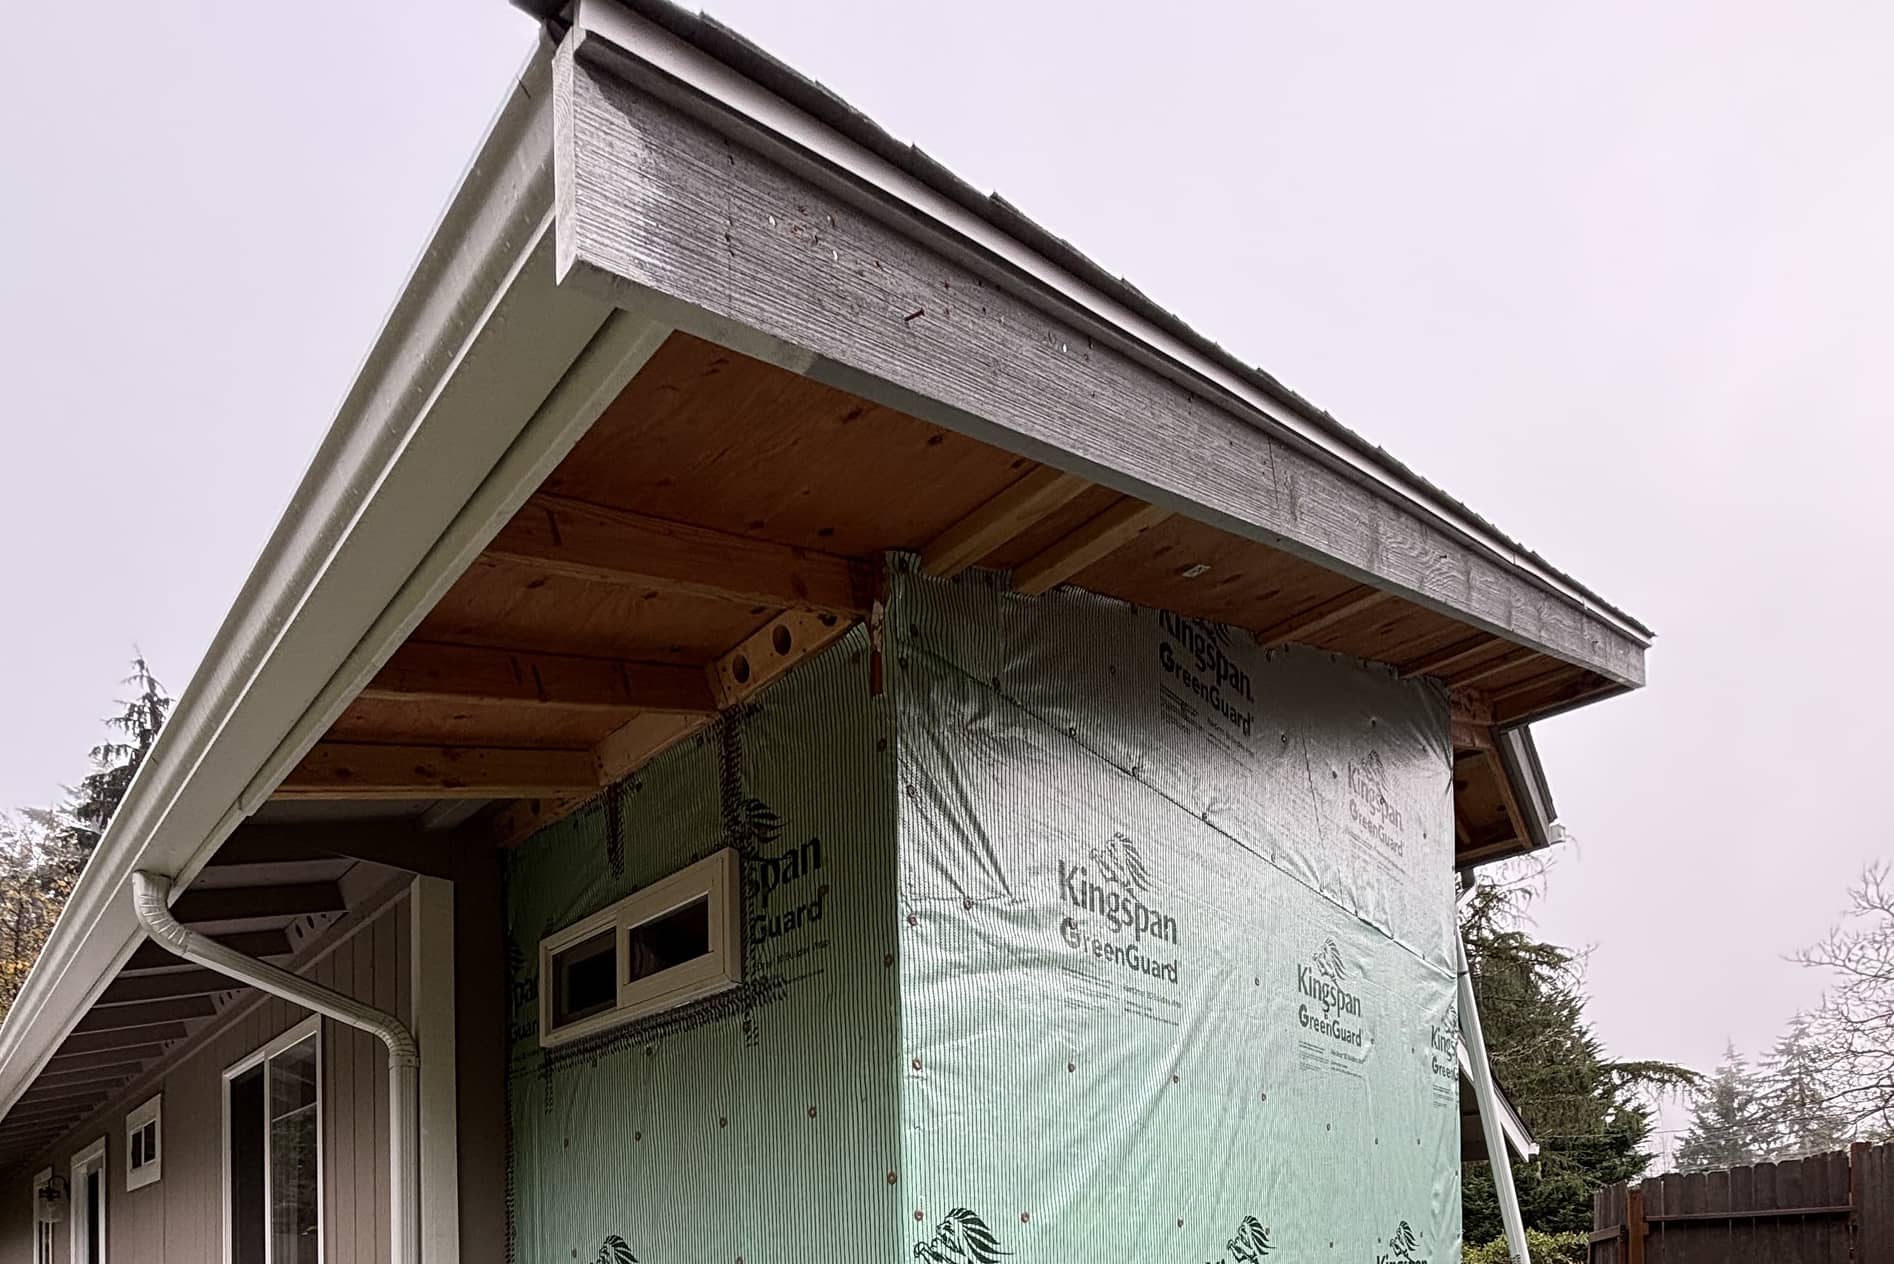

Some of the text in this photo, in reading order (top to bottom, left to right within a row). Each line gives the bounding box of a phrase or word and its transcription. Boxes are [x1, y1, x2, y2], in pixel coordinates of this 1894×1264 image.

[1159, 609, 1251, 696] Kingspan
[1348, 760, 1402, 832] Kingspan
[1058, 859, 1177, 945] Kingspan
[1060, 917, 1178, 985] GreenGuard
[1298, 963, 1361, 1018] Kingspan
[1299, 1003, 1362, 1048] GreenGuard
